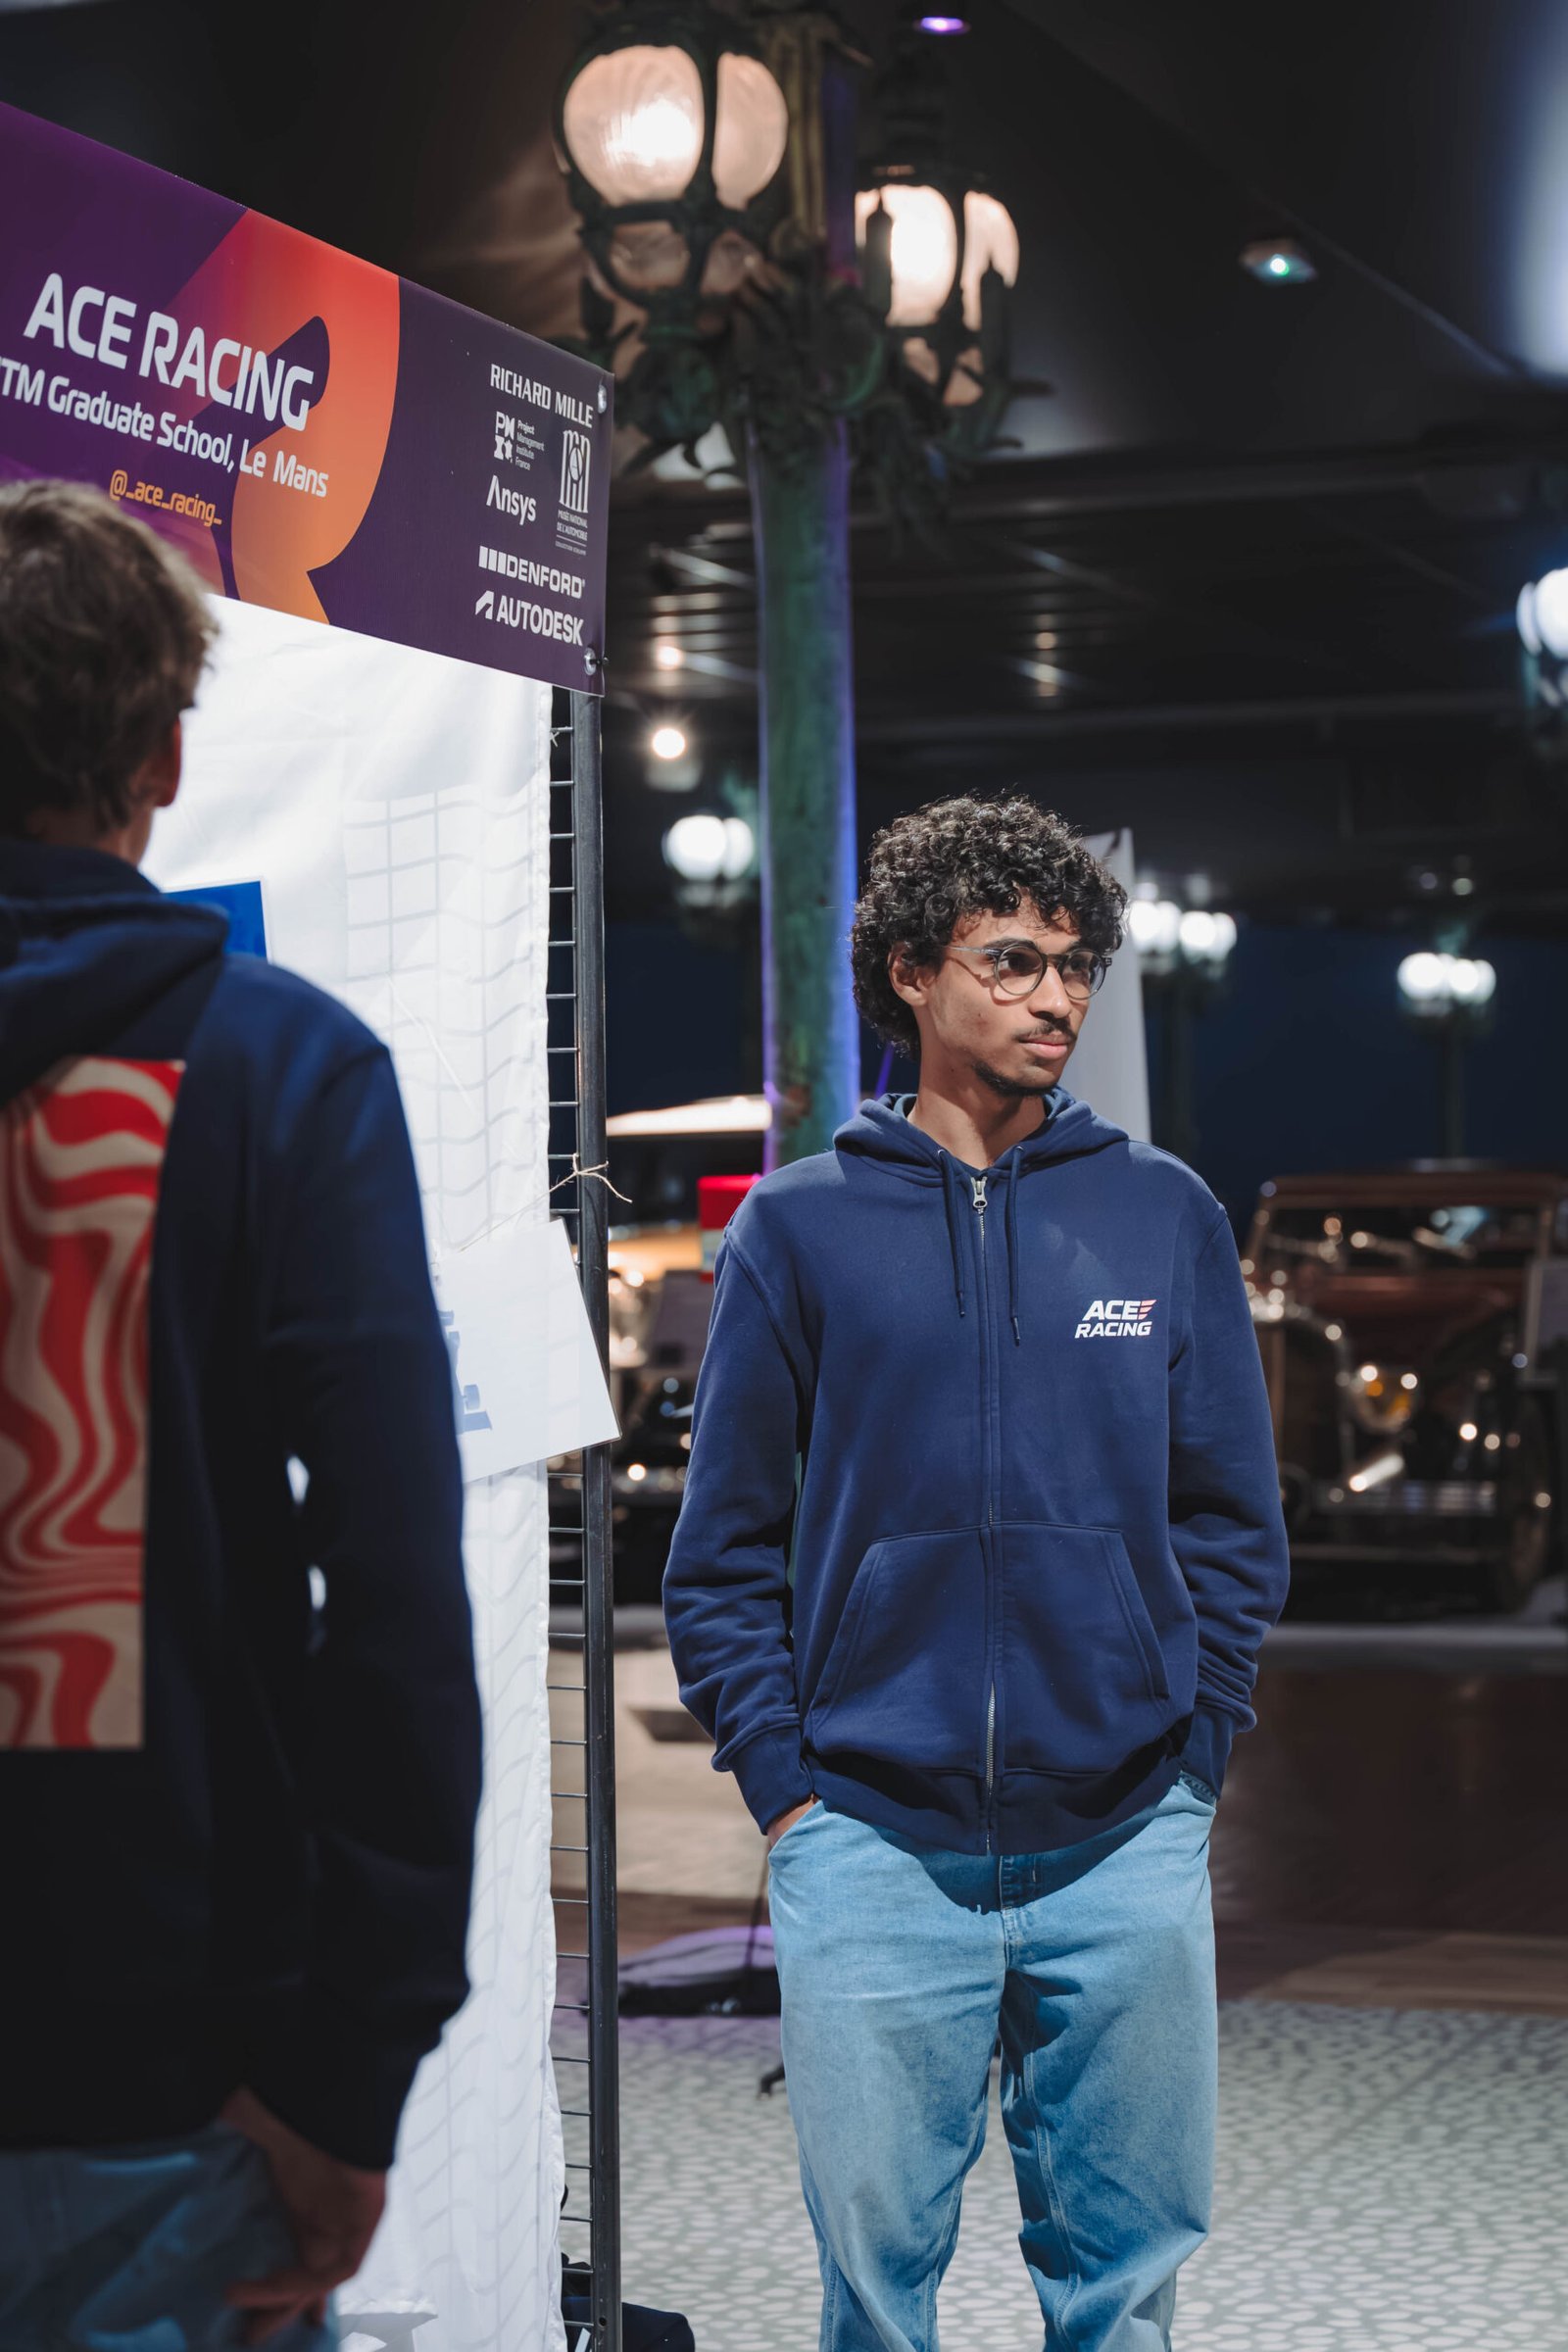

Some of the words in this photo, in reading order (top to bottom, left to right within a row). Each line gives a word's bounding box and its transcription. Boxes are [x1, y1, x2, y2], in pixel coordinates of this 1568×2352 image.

[23, 272, 137, 369] ACE
[138, 311, 315, 431] RACING
[490, 364, 552, 410] RICHARD
[555, 391, 594, 428] MILLE
[0, 356, 45, 407] TM
[47, 375, 155, 441] Graduate
[156, 412, 235, 473] School,
[239, 439, 267, 477] Le
[272, 450, 329, 498] Mans
[109, 469, 222, 527] @_ace_racing_
[486, 474, 537, 526] Ansys
[506, 554, 585, 599] DENFORD
[496, 594, 585, 647] AUTODESK
[1074, 1321, 1152, 1339] RACING
[1082, 1299, 1142, 1321] ACE
